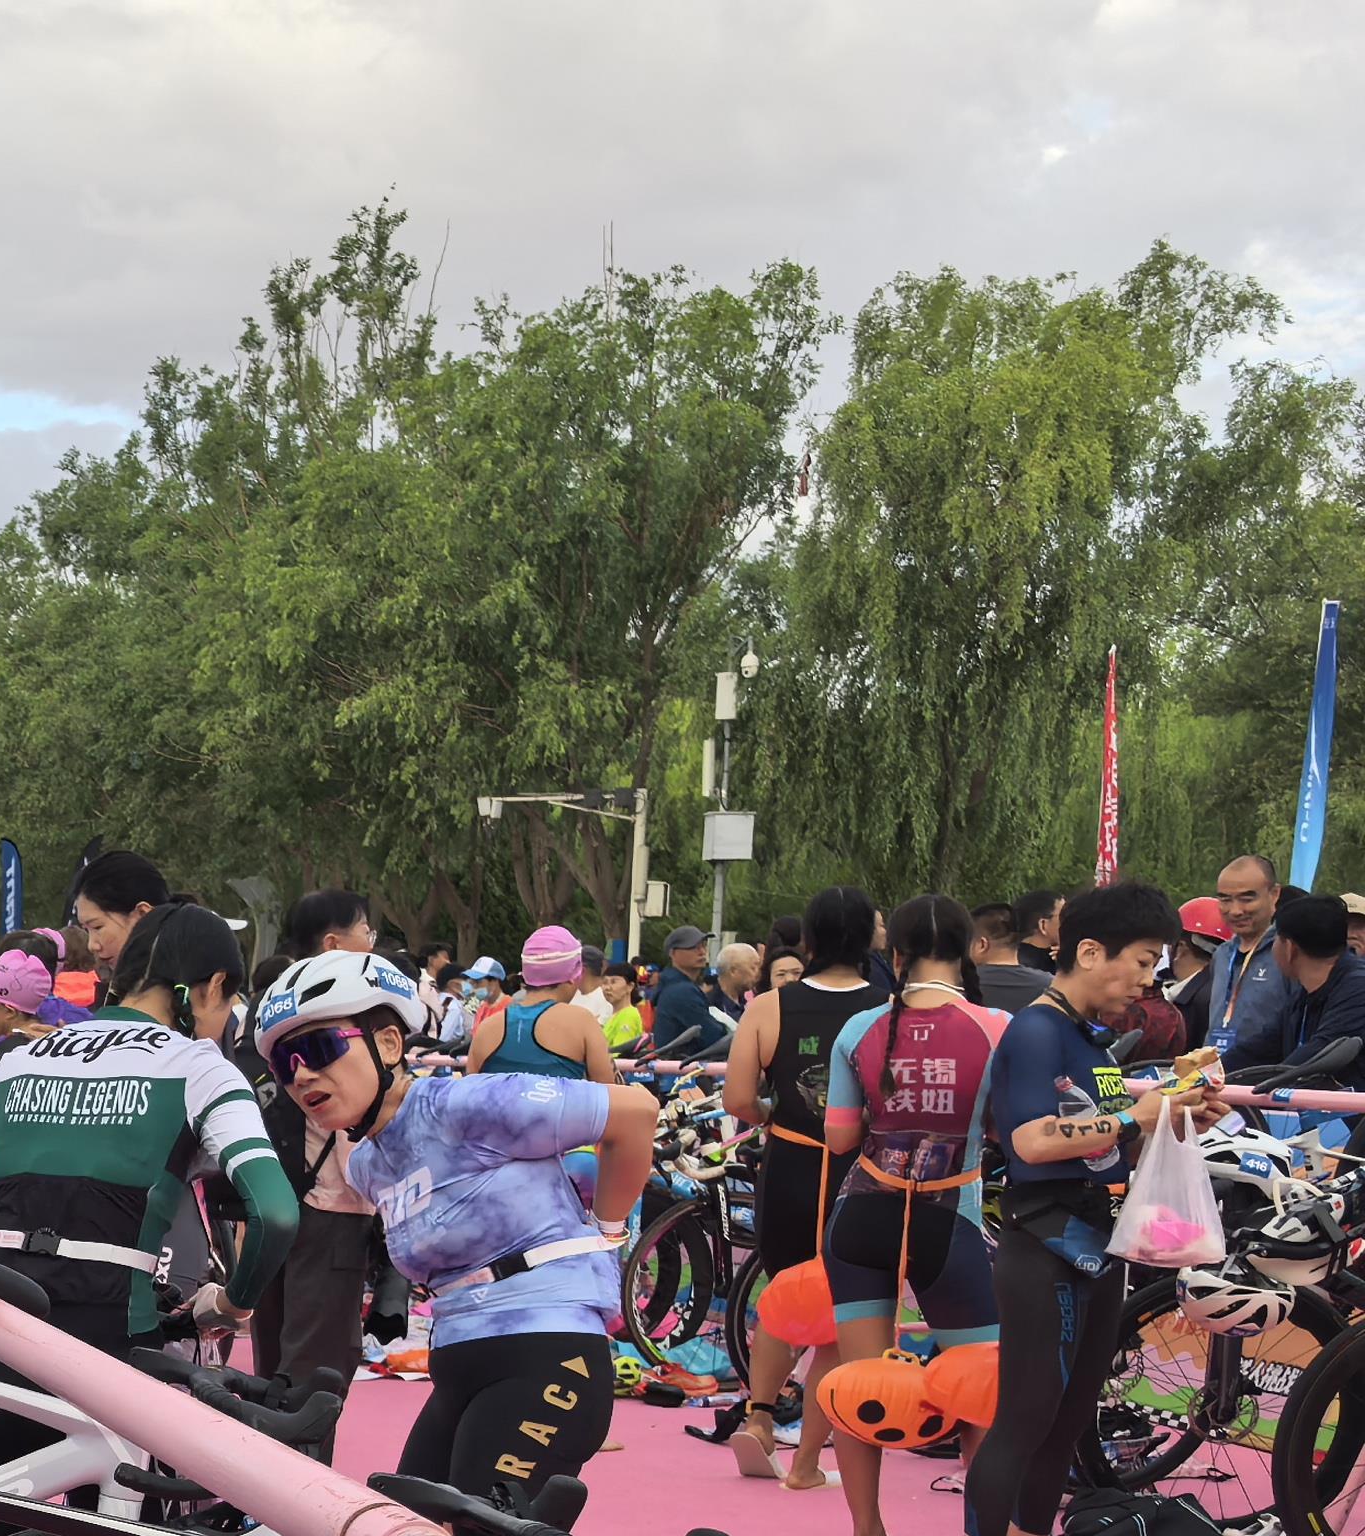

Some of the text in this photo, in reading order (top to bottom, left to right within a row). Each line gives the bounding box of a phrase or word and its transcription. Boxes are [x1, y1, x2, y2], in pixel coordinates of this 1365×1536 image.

[382, 968, 410, 993] 1068
[4, 1079, 152, 1117] CHASING LEGENDS
[1245, 1157, 1269, 1173] 416
